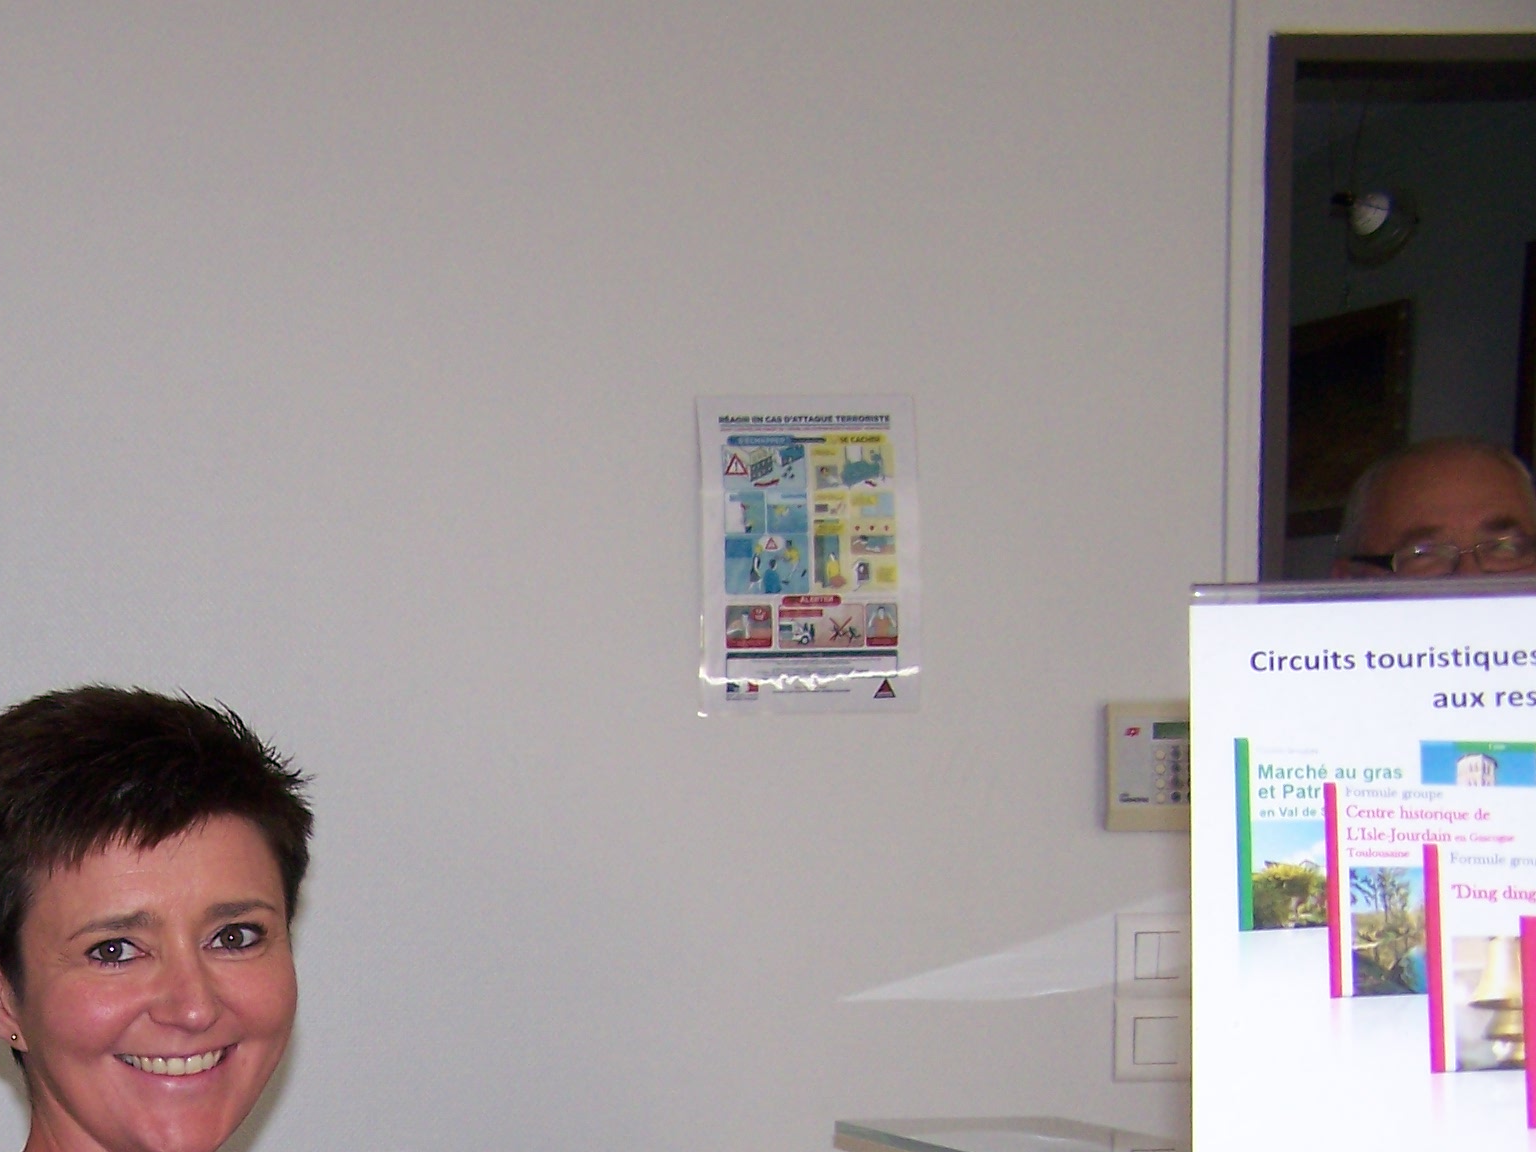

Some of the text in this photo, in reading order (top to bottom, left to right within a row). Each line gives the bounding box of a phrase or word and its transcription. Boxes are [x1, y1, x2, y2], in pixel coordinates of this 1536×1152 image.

[751, 415, 764, 423] EN
[765, 415, 782, 423] CAS
[784, 414, 833, 423] D'ATTAQUE
[835, 414, 890, 423] TERRORISTE
[1250, 646, 1536, 672] Circuits touristiques
[1433, 690, 1536, 708] aux res
[1258, 764, 1403, 782] Marché au gras
[1258, 785, 1275, 799] et
[1345, 787, 1443, 801] Formule groupe
[1260, 809, 1275, 818] en
[1279, 806, 1297, 817] Val
[1302, 806, 1317, 817] de
[1346, 805, 1491, 823] Centre historique de
[1346, 827, 1452, 843] L'Isle-Jourdain
[1450, 851, 1505, 865] Formule
